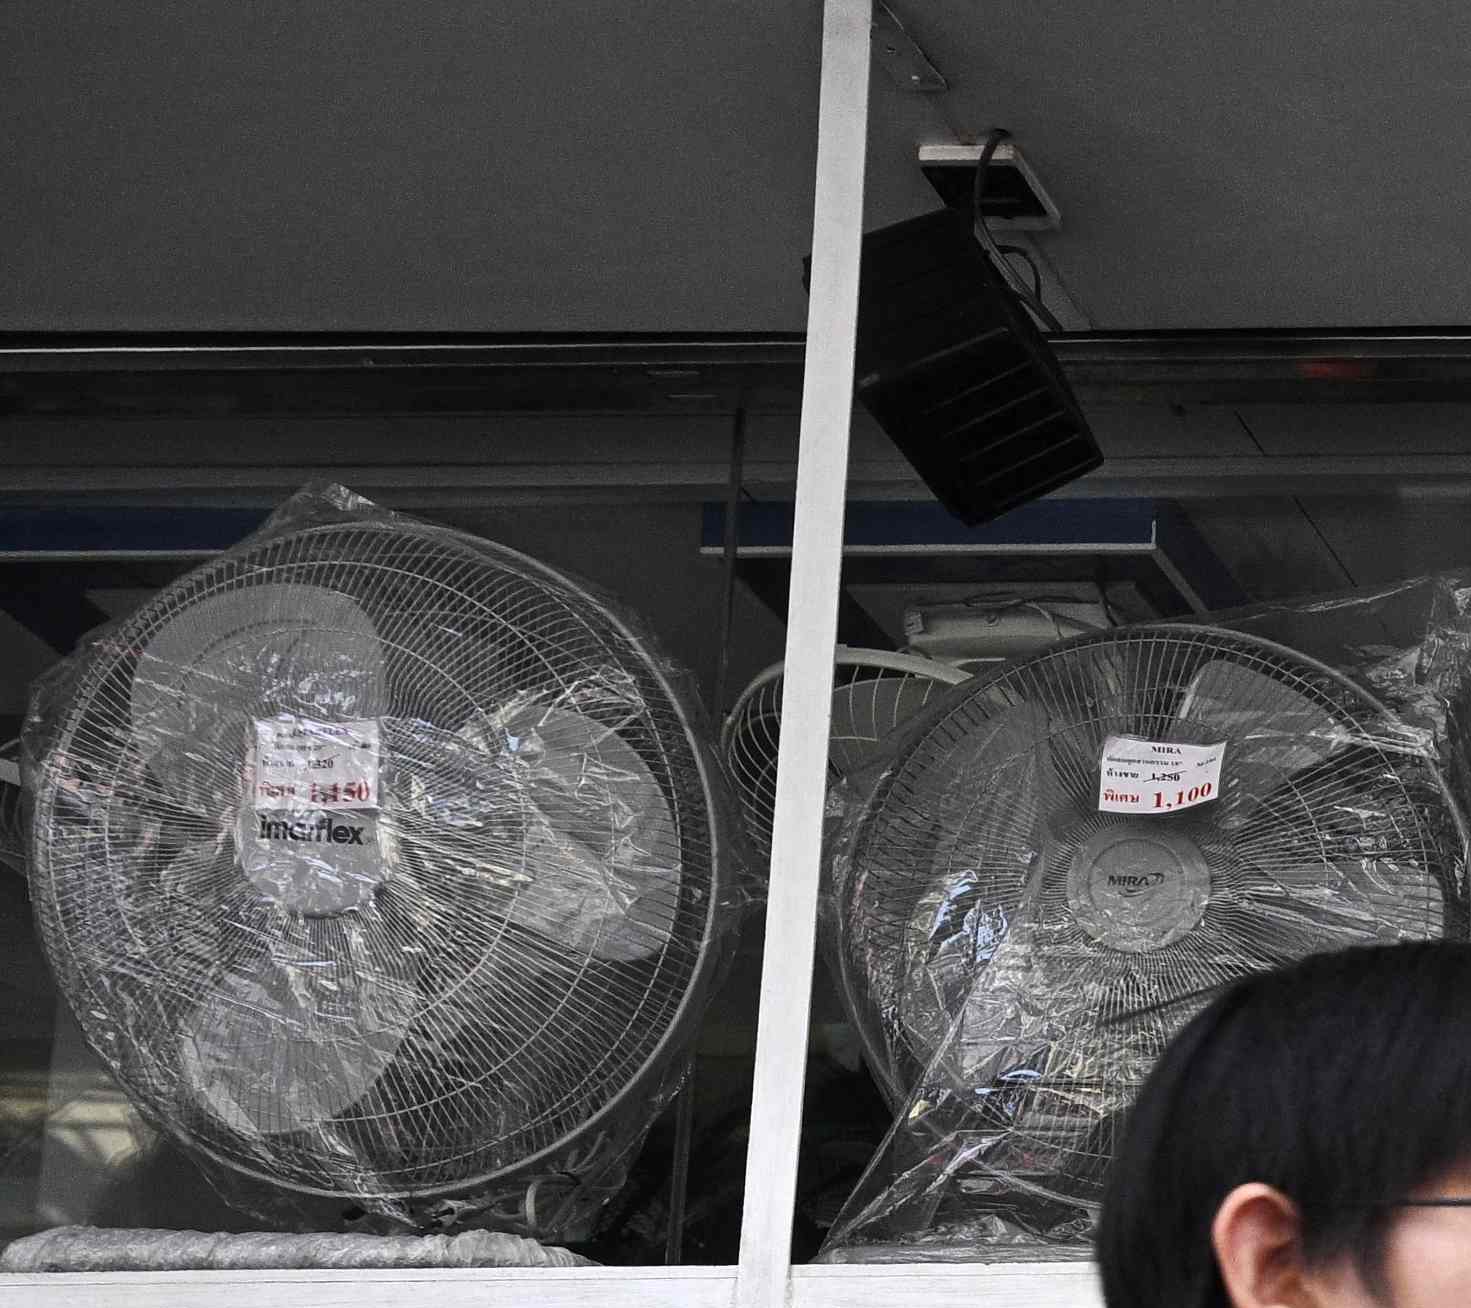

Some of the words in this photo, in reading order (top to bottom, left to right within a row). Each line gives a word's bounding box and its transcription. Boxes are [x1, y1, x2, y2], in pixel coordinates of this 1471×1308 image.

[1151, 746, 1182, 755] MIRA
[1104, 789, 1140, 803] พิเศษ
[1153, 783, 1212, 810] 1,100
[1107, 875, 1150, 887] MIRA
